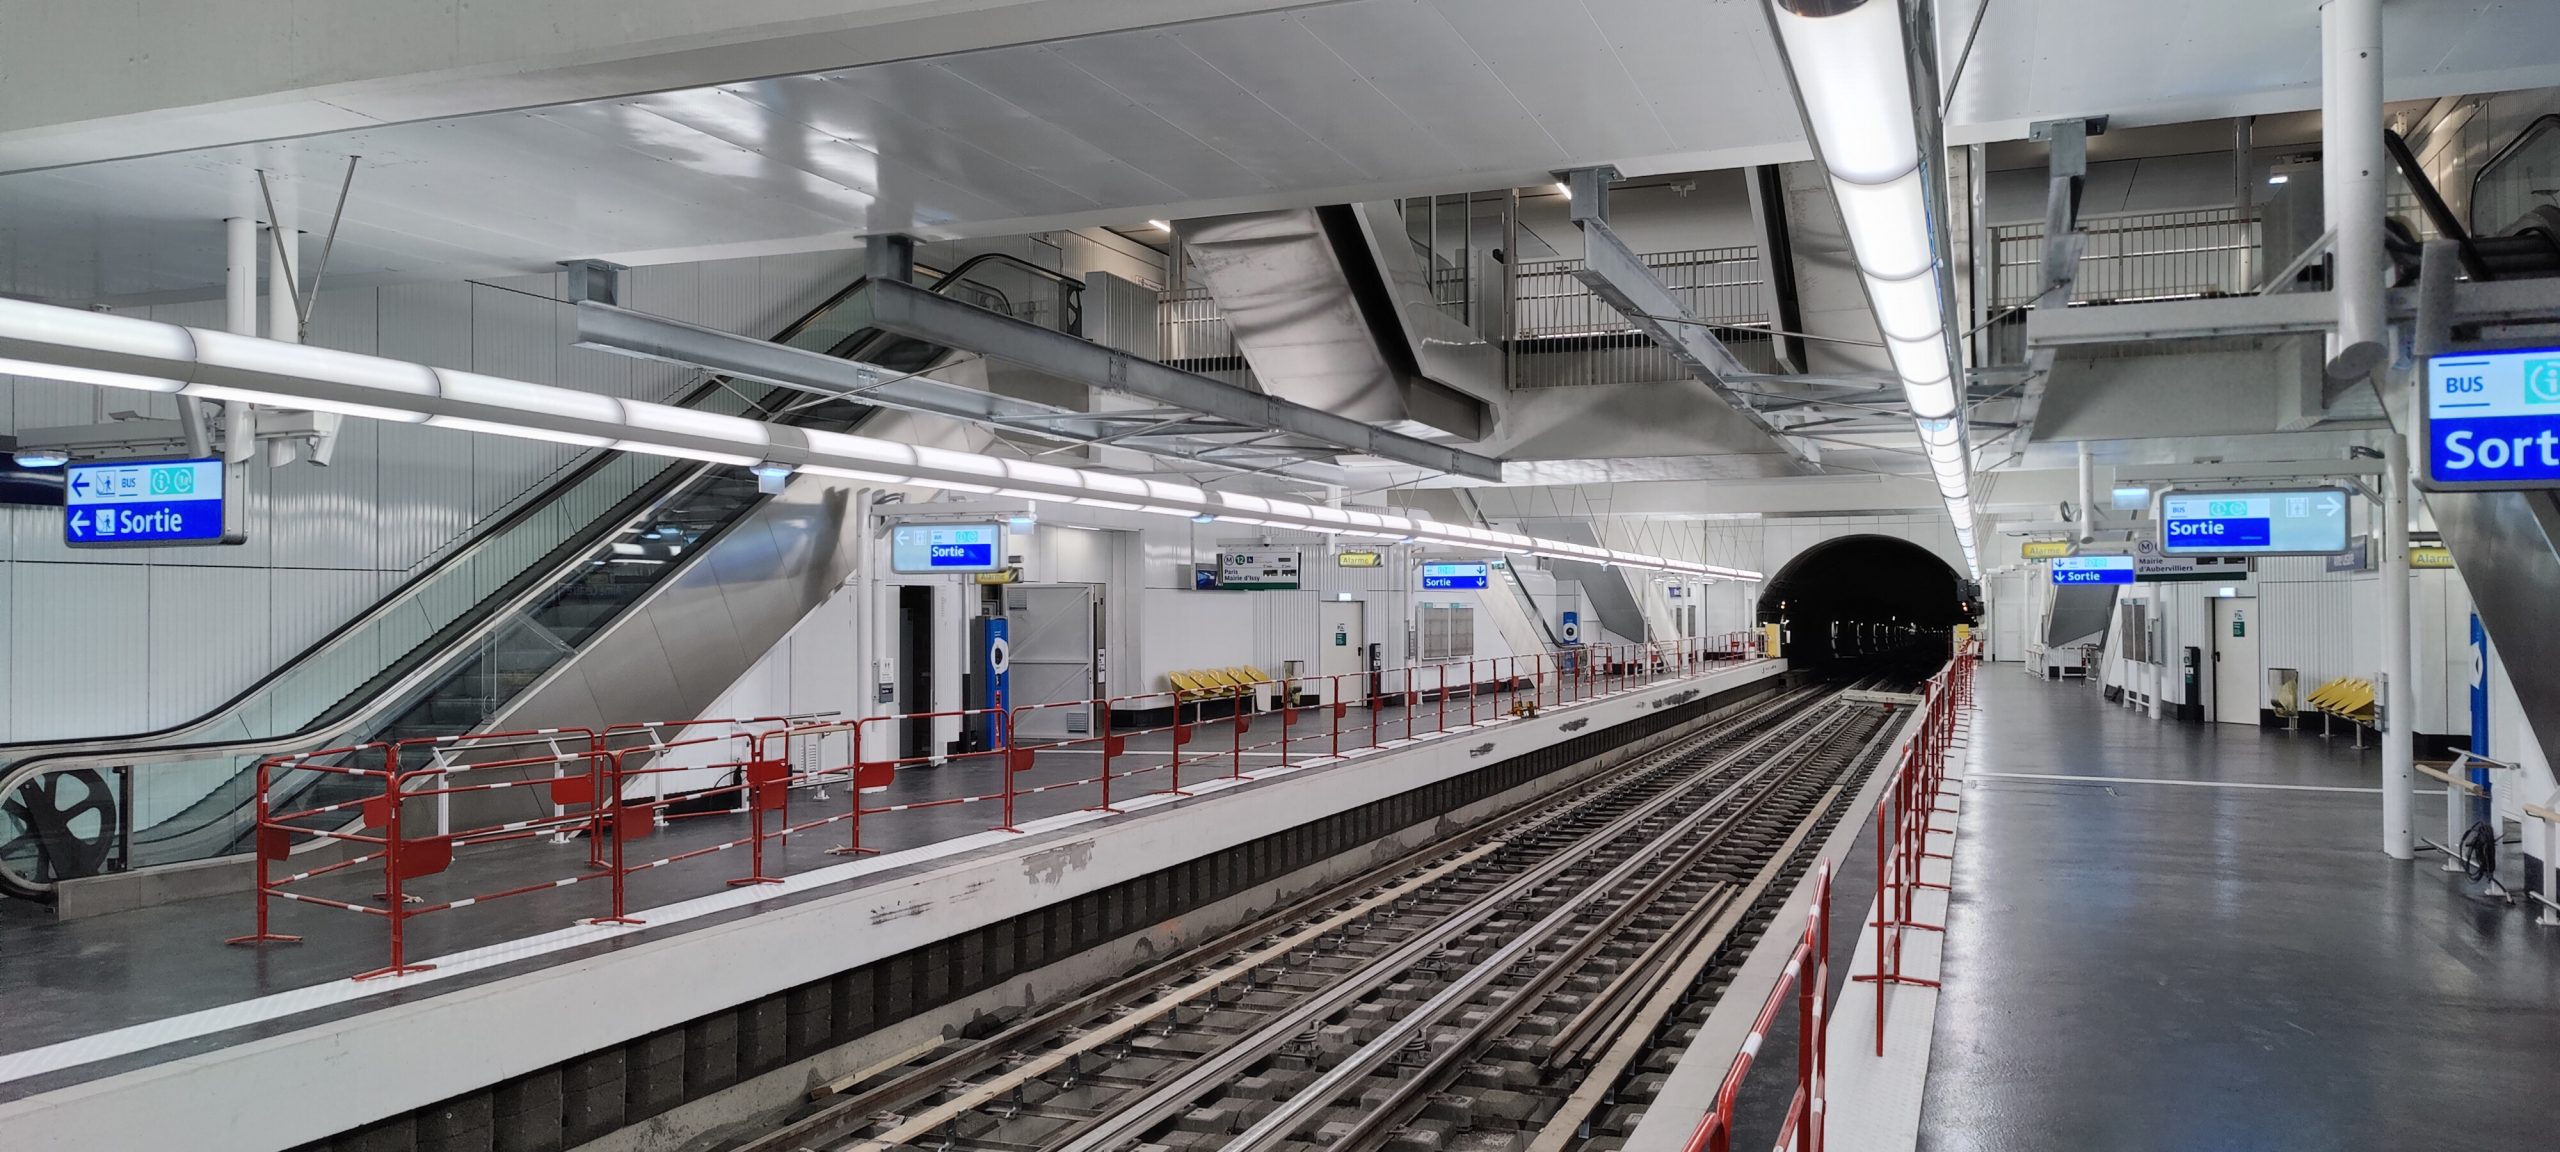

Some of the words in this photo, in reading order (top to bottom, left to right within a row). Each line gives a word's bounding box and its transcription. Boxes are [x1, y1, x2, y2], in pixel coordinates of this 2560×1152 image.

[2446, 376, 2483, 394] BUS
[2445, 429, 2560, 470] Sort
[121, 477, 136, 489] BUS
[121, 507, 182, 534] Sortie
[2169, 521, 2225, 536] Sortie
[932, 545, 965, 558] Sortie
[2031, 547, 2061, 555] Alarme
[1236, 556, 1244, 564] 12
[1342, 556, 1369, 564] Alarme
[1425, 577, 1451, 587] Sortie
[2068, 572, 2100, 581] Sortie
